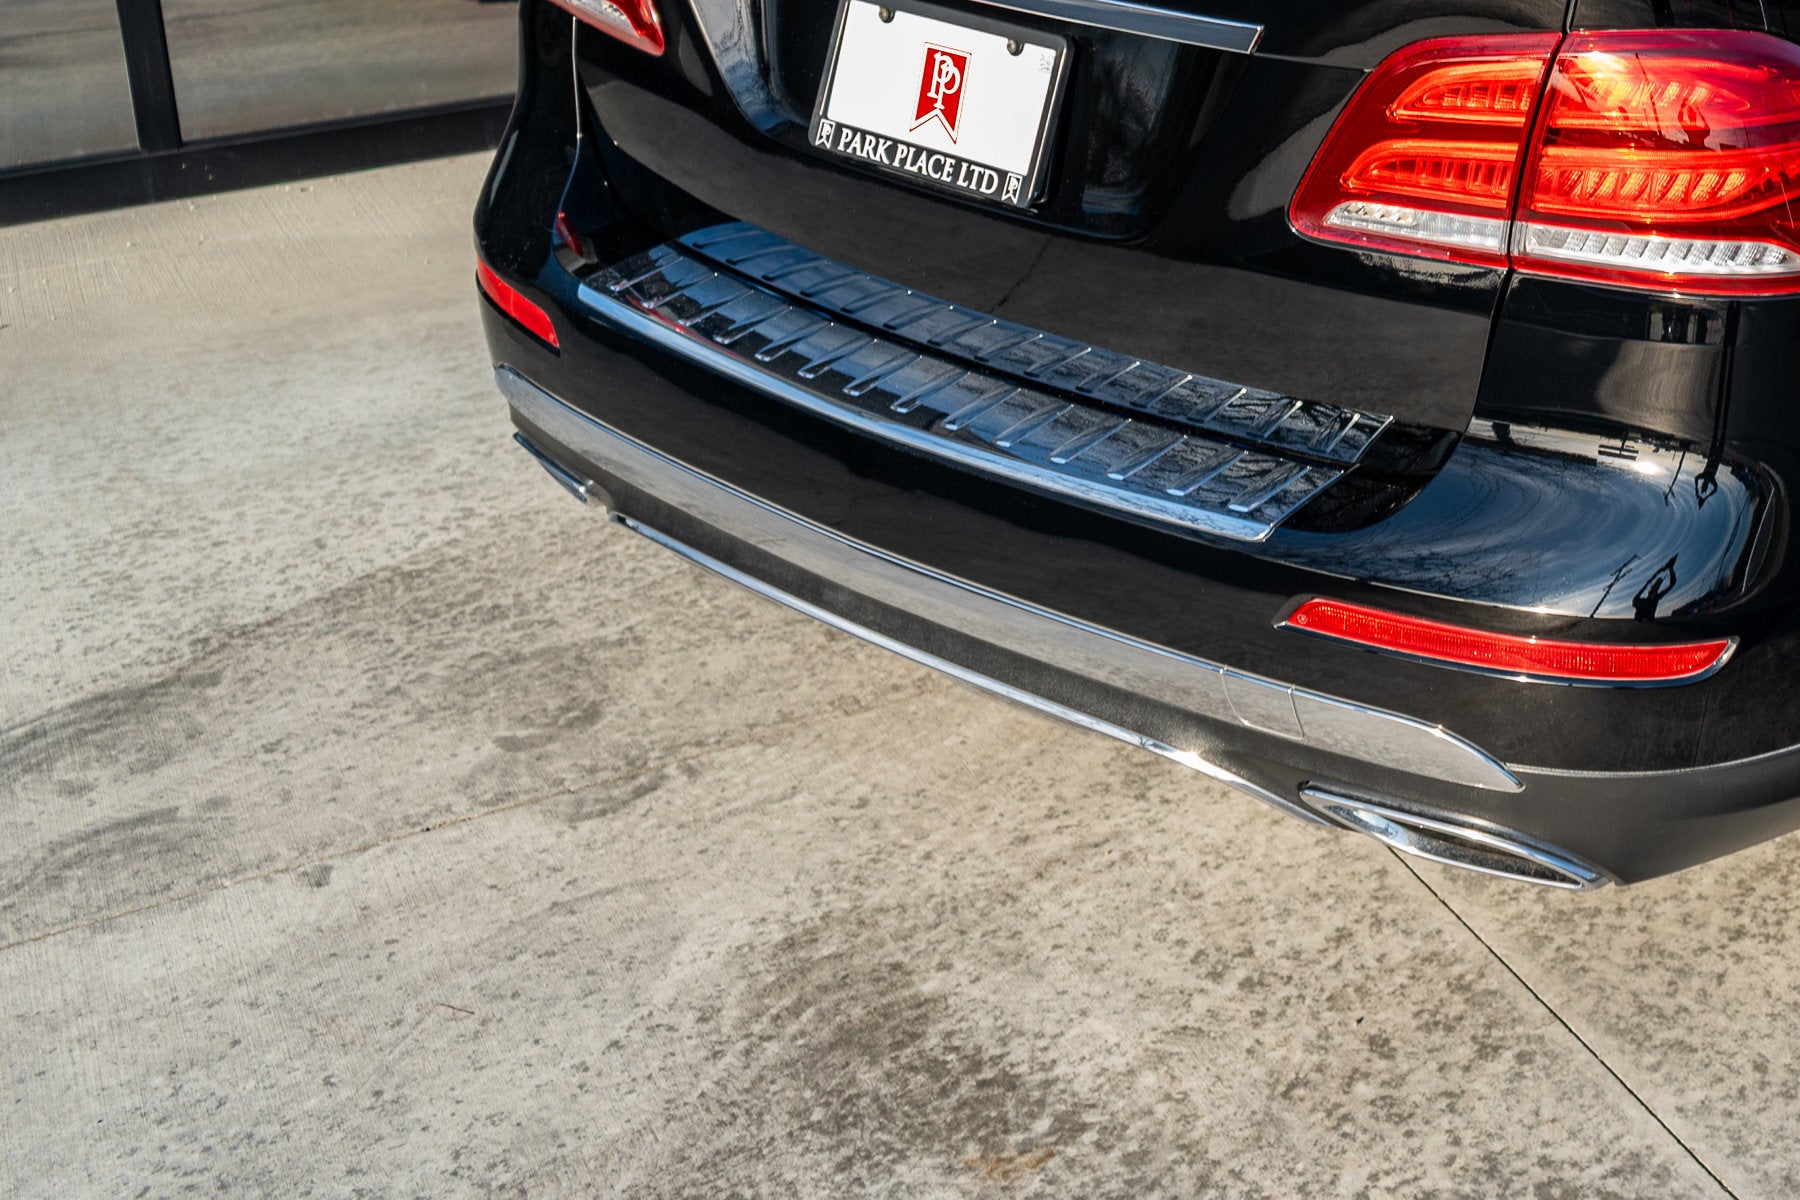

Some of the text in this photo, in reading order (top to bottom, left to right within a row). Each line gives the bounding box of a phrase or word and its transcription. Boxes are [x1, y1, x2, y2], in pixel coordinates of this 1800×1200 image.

[837, 128, 998, 194] PARK PLACE LTD
